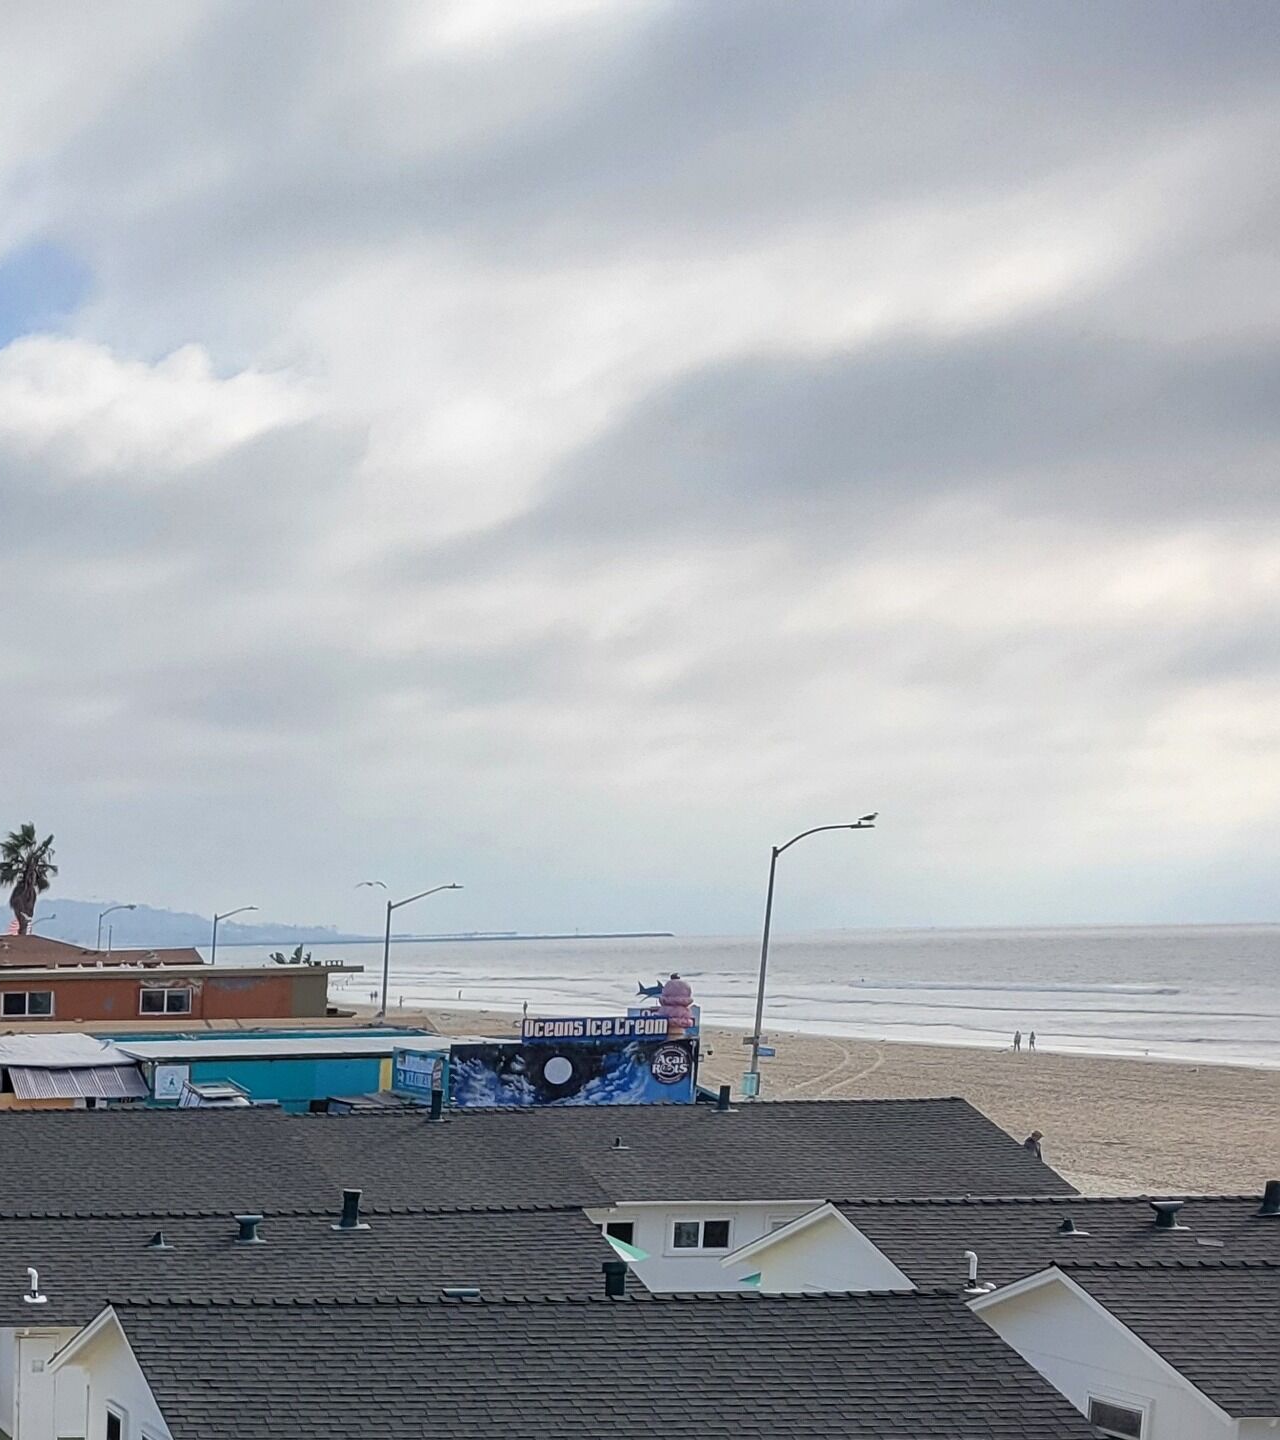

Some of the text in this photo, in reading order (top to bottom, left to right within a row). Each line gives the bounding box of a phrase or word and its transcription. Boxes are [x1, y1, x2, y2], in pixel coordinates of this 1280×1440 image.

[524, 1017, 668, 1038] Oceans Ice Cream
